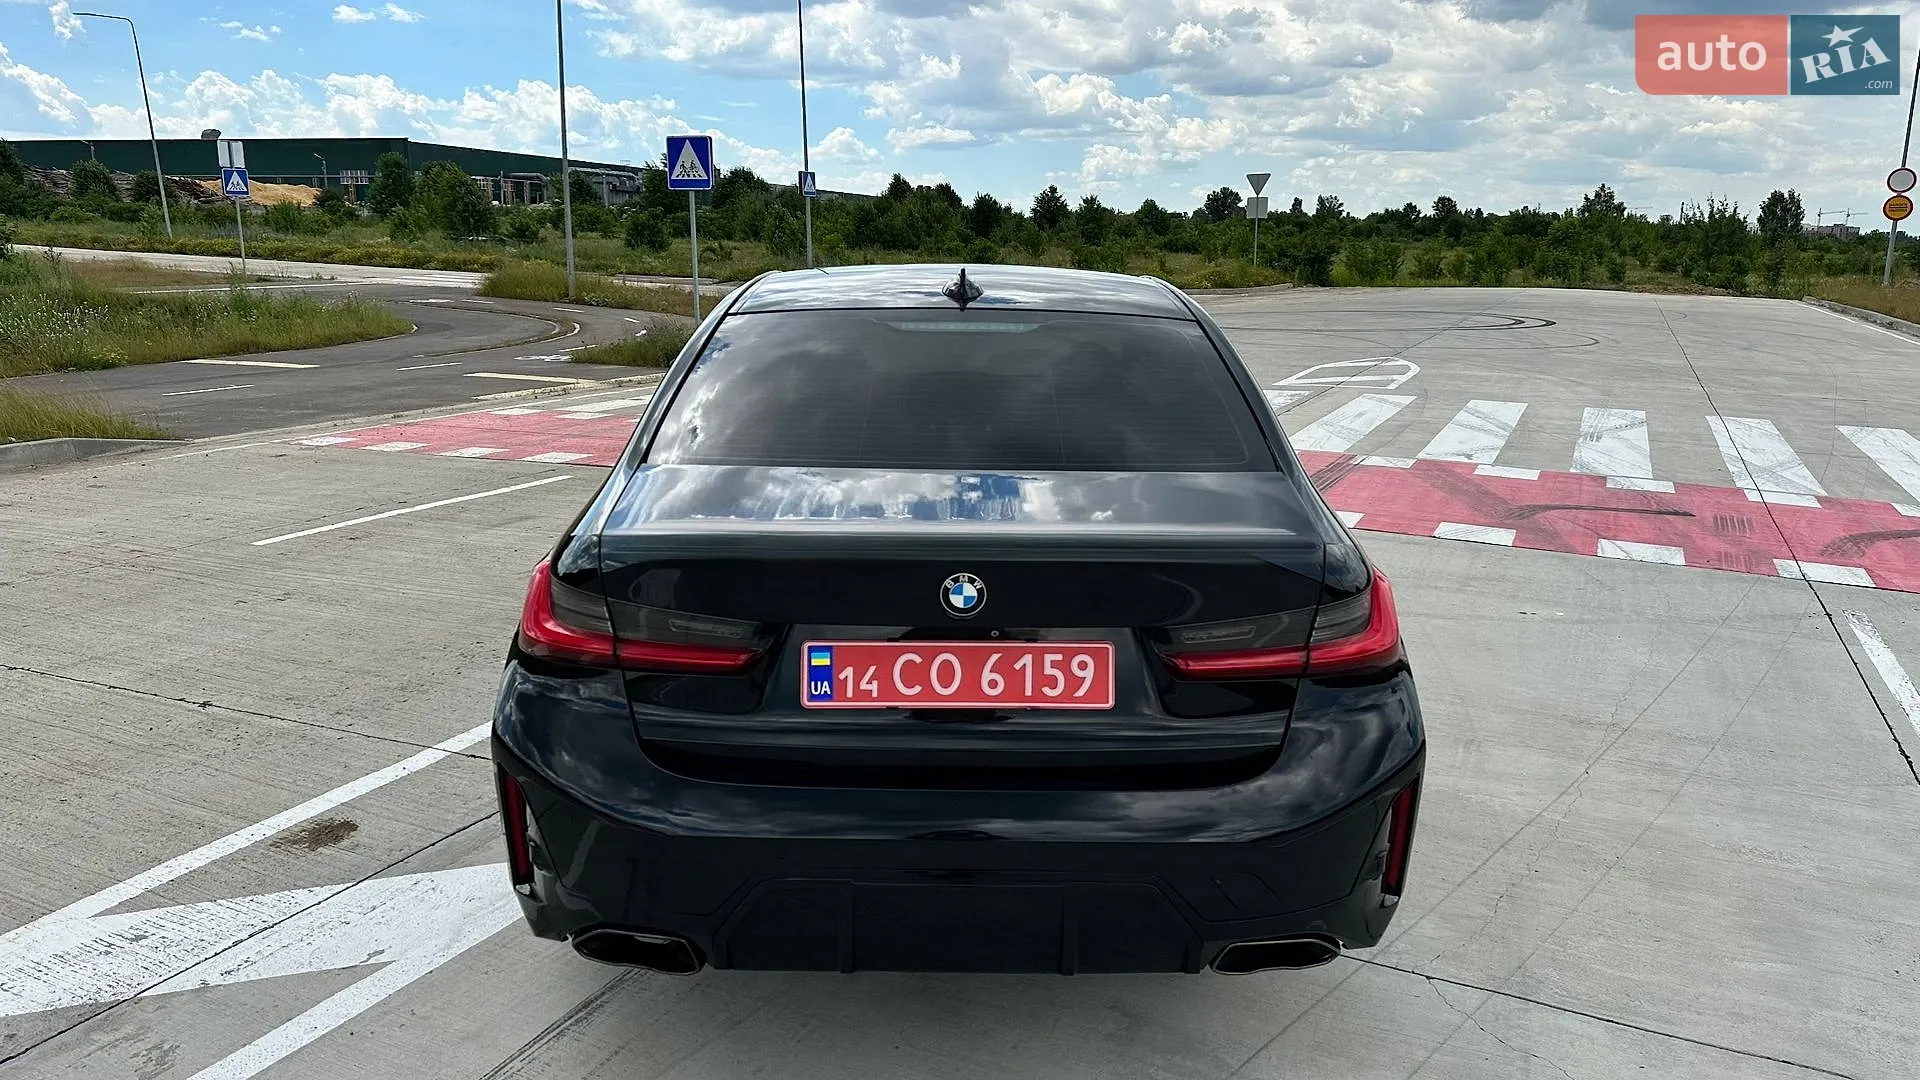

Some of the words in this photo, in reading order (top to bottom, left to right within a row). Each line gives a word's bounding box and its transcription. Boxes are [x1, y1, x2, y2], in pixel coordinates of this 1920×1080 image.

[810, 680, 831, 695] UA
[838, 665, 879, 698] 14
[892, 652, 962, 697] CO
[980, 653, 1095, 698] 6159
